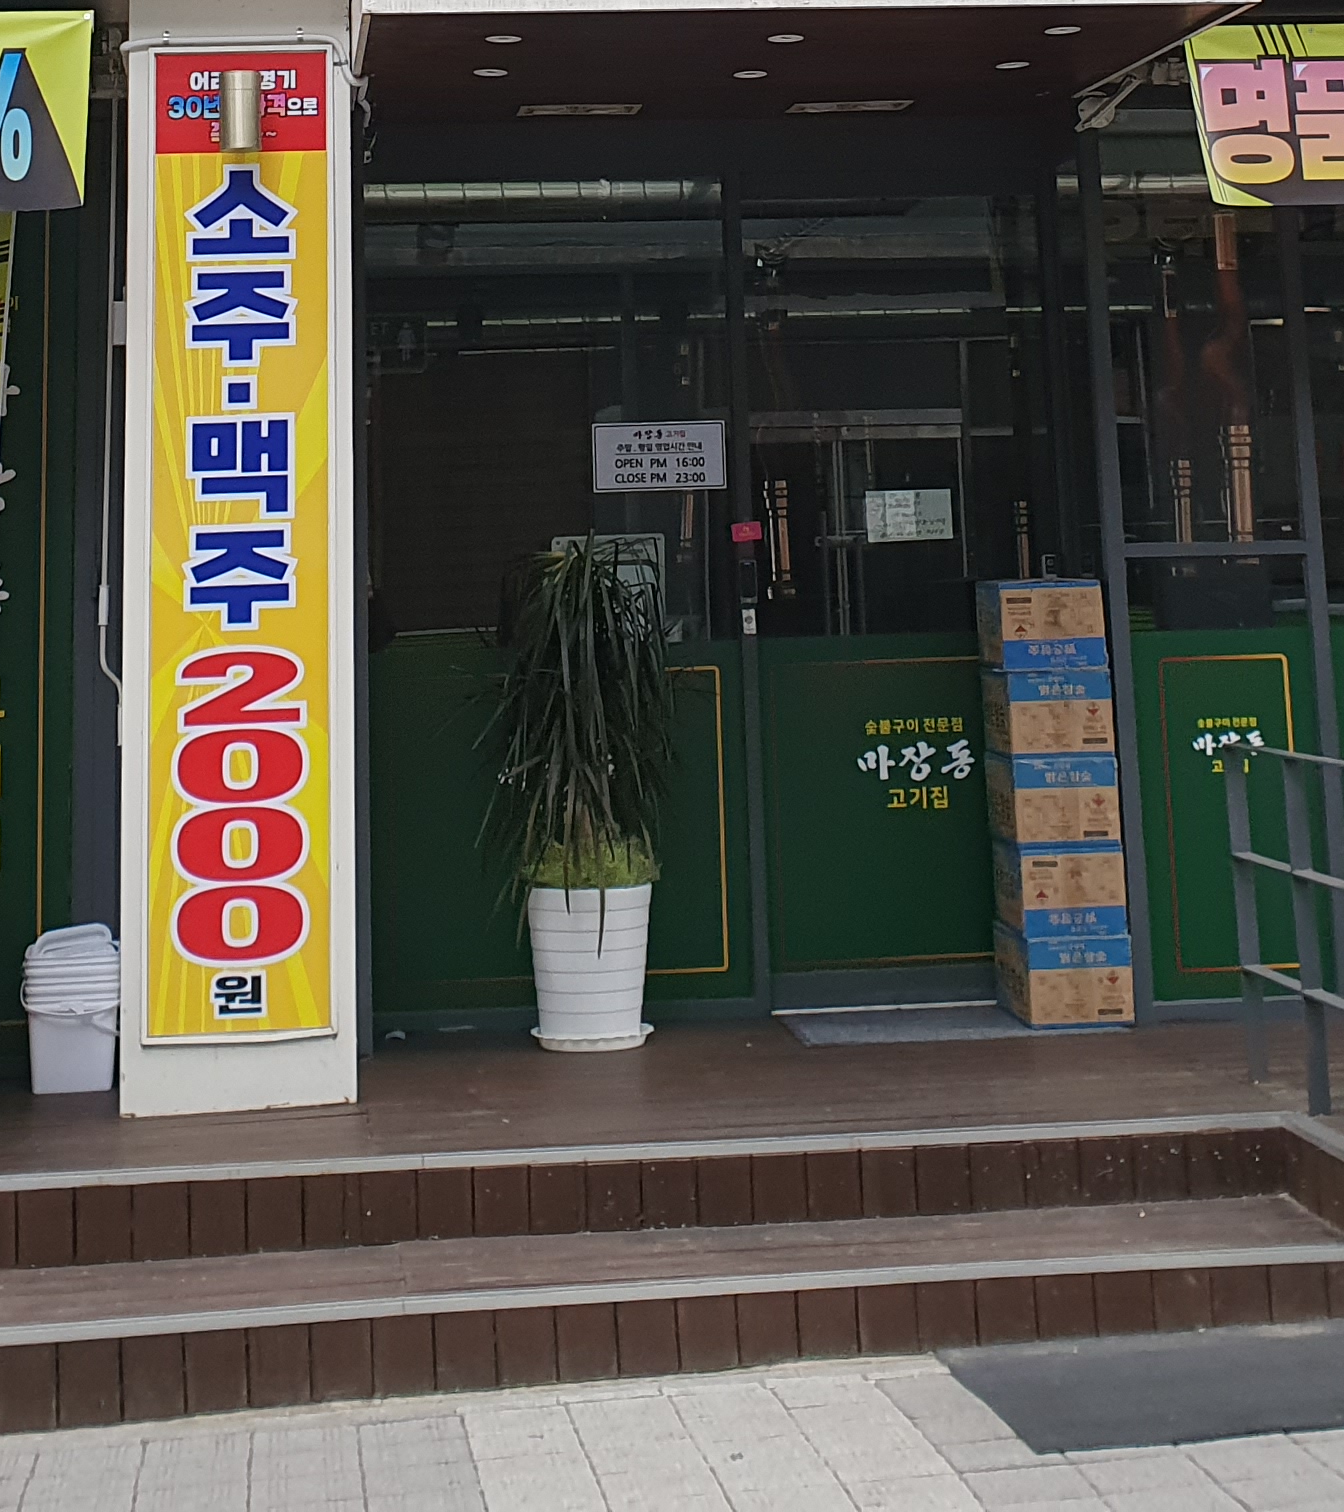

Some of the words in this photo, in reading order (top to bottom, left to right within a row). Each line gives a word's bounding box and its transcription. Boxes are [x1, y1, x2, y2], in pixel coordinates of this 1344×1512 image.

[258, 92, 319, 118] 격으로
[614, 457, 643, 469] OPEN
[650, 457, 667, 468] PM
[675, 456, 705, 468] 16:00
[614, 472, 647, 484] CLOSE
[650, 472, 667, 483] PM
[675, 472, 706, 484] 23:00
[856, 738, 976, 782] 마장동
[886, 785, 950, 810] 고기집
